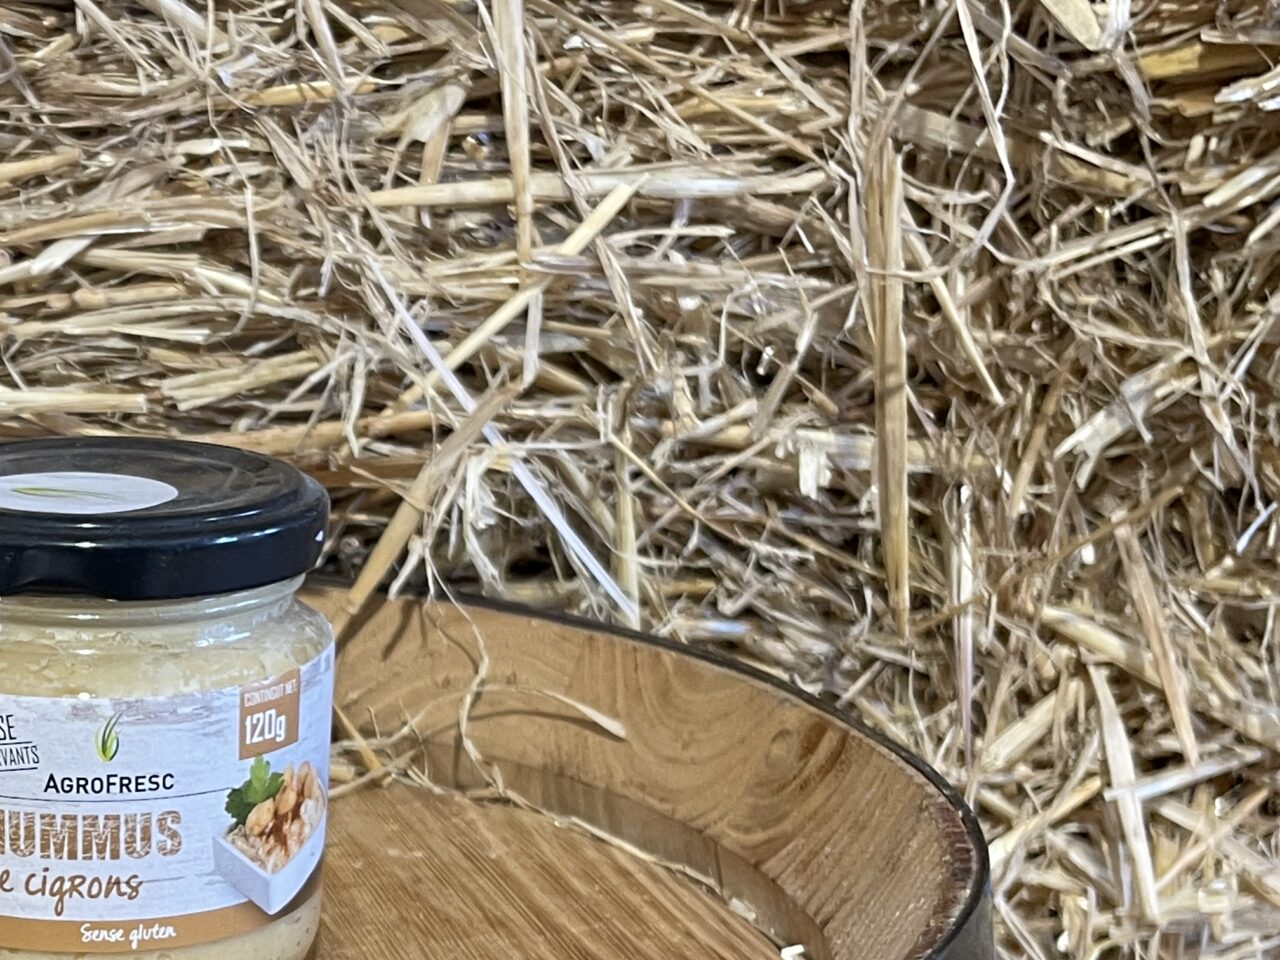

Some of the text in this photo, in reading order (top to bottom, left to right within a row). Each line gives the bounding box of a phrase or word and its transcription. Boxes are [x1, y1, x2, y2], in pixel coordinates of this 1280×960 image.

[245, 708, 286, 745] 120g
[80, 923, 177, 950] Sense gluten
